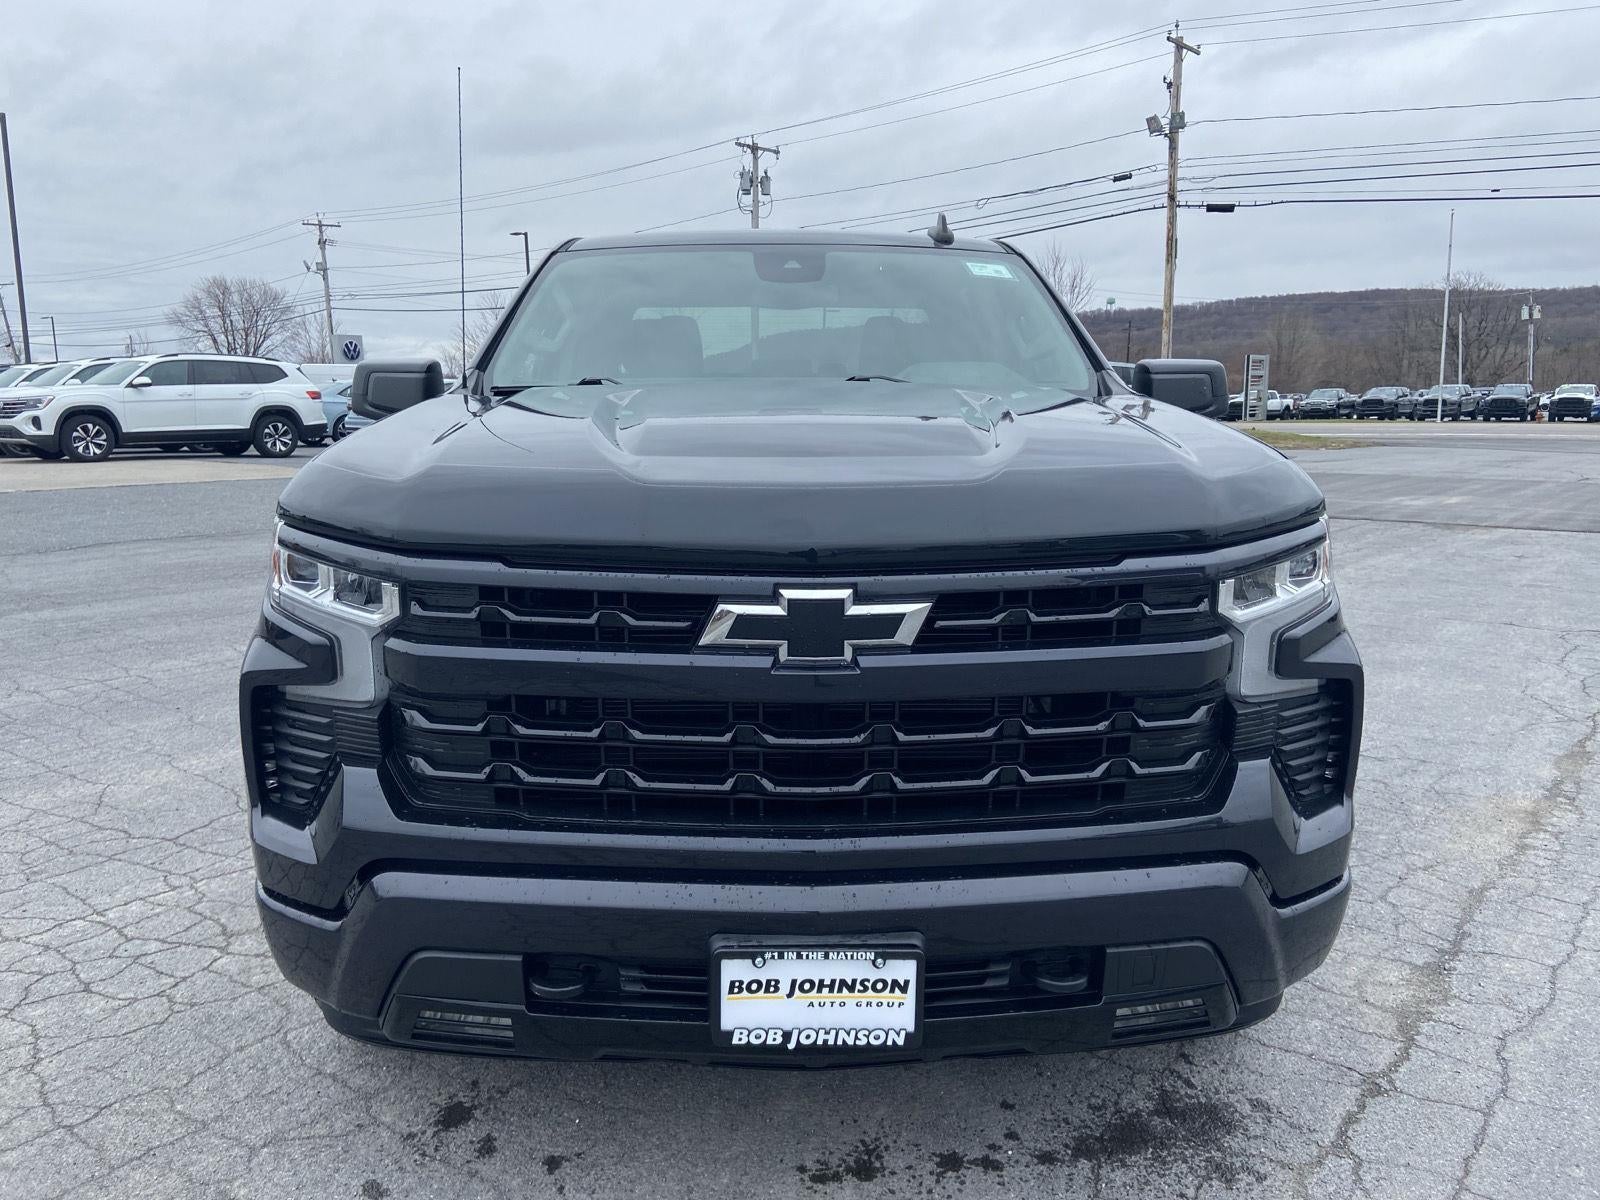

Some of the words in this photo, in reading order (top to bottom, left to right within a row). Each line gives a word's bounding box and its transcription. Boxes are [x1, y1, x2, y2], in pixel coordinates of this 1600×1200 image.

[343, 340, 360, 360] VW
[764, 951, 779, 960] #1
[784, 951, 796, 960] IN
[801, 951, 825, 960] THE
[829, 951, 875, 960] NATION
[727, 978, 781, 996] BOB
[786, 978, 910, 999] JOHNSON
[731, 1028, 783, 1045] BOB
[787, 1027, 906, 1050] JOHNSON
